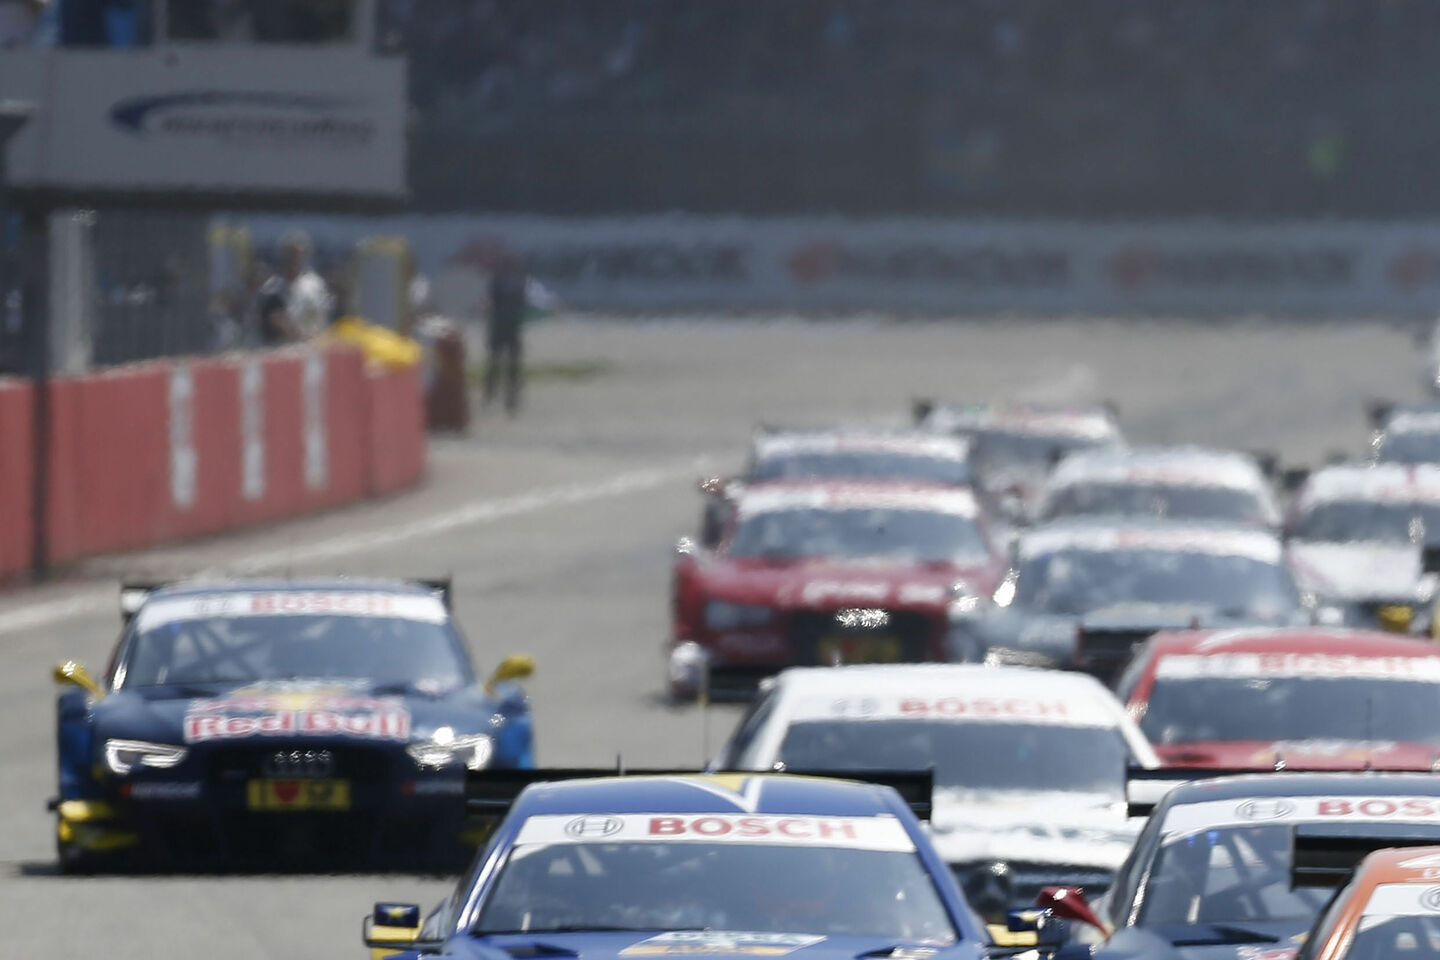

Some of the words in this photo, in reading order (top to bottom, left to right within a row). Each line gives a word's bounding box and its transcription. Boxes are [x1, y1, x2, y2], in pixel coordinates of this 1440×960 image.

[899, 698, 1068, 715] BOSCH
[187, 711, 292, 739] Red
[303, 711, 411, 741] Bull
[648, 817, 858, 839] BOSCH
